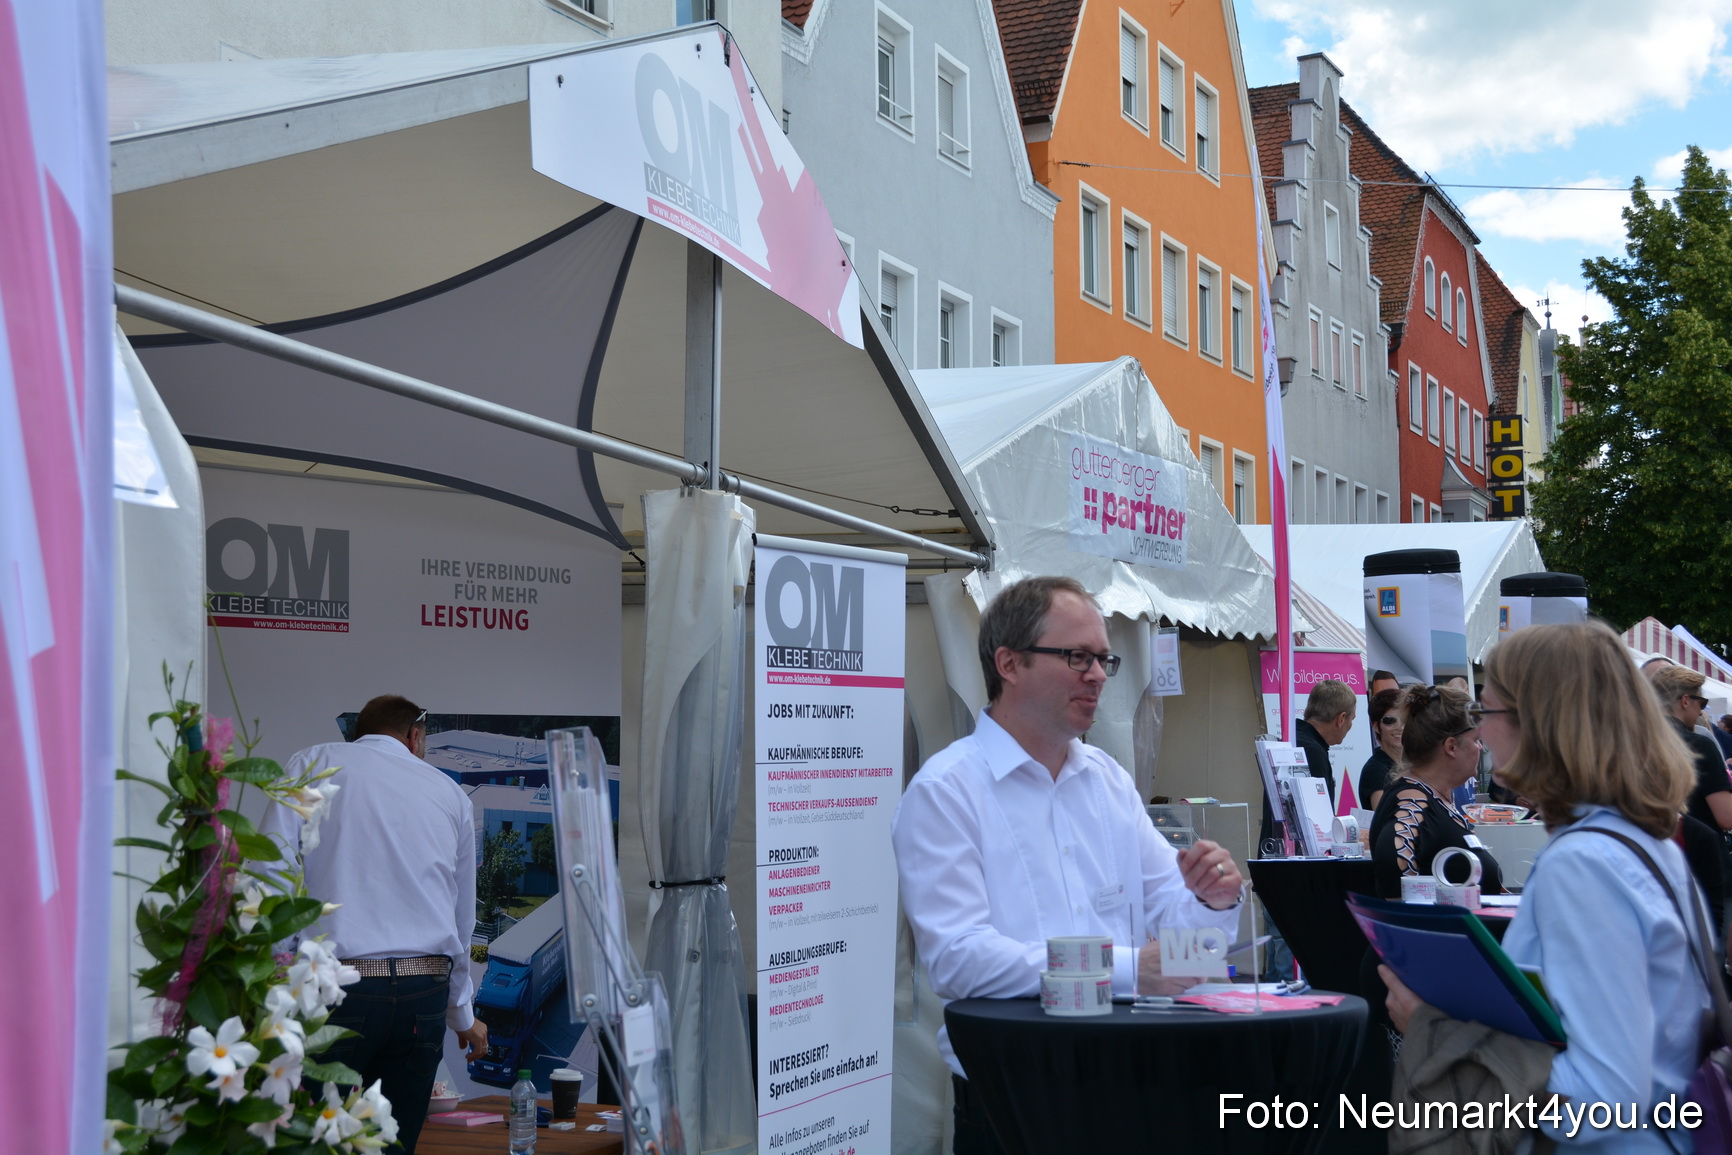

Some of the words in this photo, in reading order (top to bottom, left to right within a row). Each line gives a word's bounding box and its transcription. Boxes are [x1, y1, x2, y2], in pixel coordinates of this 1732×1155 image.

[635, 53, 733, 212] OM
[647, 166, 693, 212] KLEBE
[693, 193, 741, 244] TECHNIK
[652, 203, 720, 248] www.om-klebetechnik.de
[1102, 490, 1186, 541] partner
[206, 517, 350, 600] OM
[421, 558, 461, 577] IHRE
[465, 561, 572, 585] VERBINDUNG
[454, 579, 487, 603] FÜR
[491, 585, 539, 605] MEHR
[765, 554, 865, 651] OM
[270, 599, 348, 618] TECHNIK
[421, 603, 530, 632] LEISTUNG
[253, 620, 348, 632] www.om-klebetechnik.de
[768, 647, 809, 668] KLEBE
[812, 650, 862, 671] TECHNIK
[768, 674, 832, 686] www.om-klebetechnik.de
[767, 703, 793, 719] JOBS
[795, 704, 810, 719] MIT
[812, 704, 854, 720] ZUKUNFT:
[767, 744, 830, 761] KAUFMÄNNISCHE
[831, 746, 864, 760] BERUFE:
[767, 768, 820, 781] KAUFMÄNNISCHER
[820, 769, 858, 780] INNENDIENST
[858, 767, 893, 778] MITARBEITER
[767, 800, 809, 812] TECHNISCHER
[809, 797, 878, 810] VERKAUFS-AUSSENDIENST
[768, 845, 819, 862] PRODUKTION:
[768, 865, 821, 880] ANLAGENBEDIENER
[768, 880, 831, 898] MASCHINENEINRICHTER
[768, 902, 804, 916] VERPACKER
[768, 940, 847, 967] AUSBILDUNGSBERUFE:
[769, 965, 820, 984] MEDIENGESTALTER
[769, 994, 824, 1017] MEDIENTECHNOLOGE
[769, 1043, 829, 1076] INTERESSIERT?
[769, 1075, 809, 1100] Sprechen
[810, 1068, 821, 1085] Sie
[822, 1066, 835, 1082] uns
[836, 1054, 865, 1076] einfach
[865, 1050, 878, 1067] an!
[769, 1135, 784, 1150] Alle
[785, 1127, 802, 1144] Infos
[803, 1126, 810, 1138] zu
[811, 1116, 835, 1134] unseren
[827, 1130, 848, 1148] finden
[848, 1125, 858, 1140] Sie
[859, 1119, 870, 1136] auf
